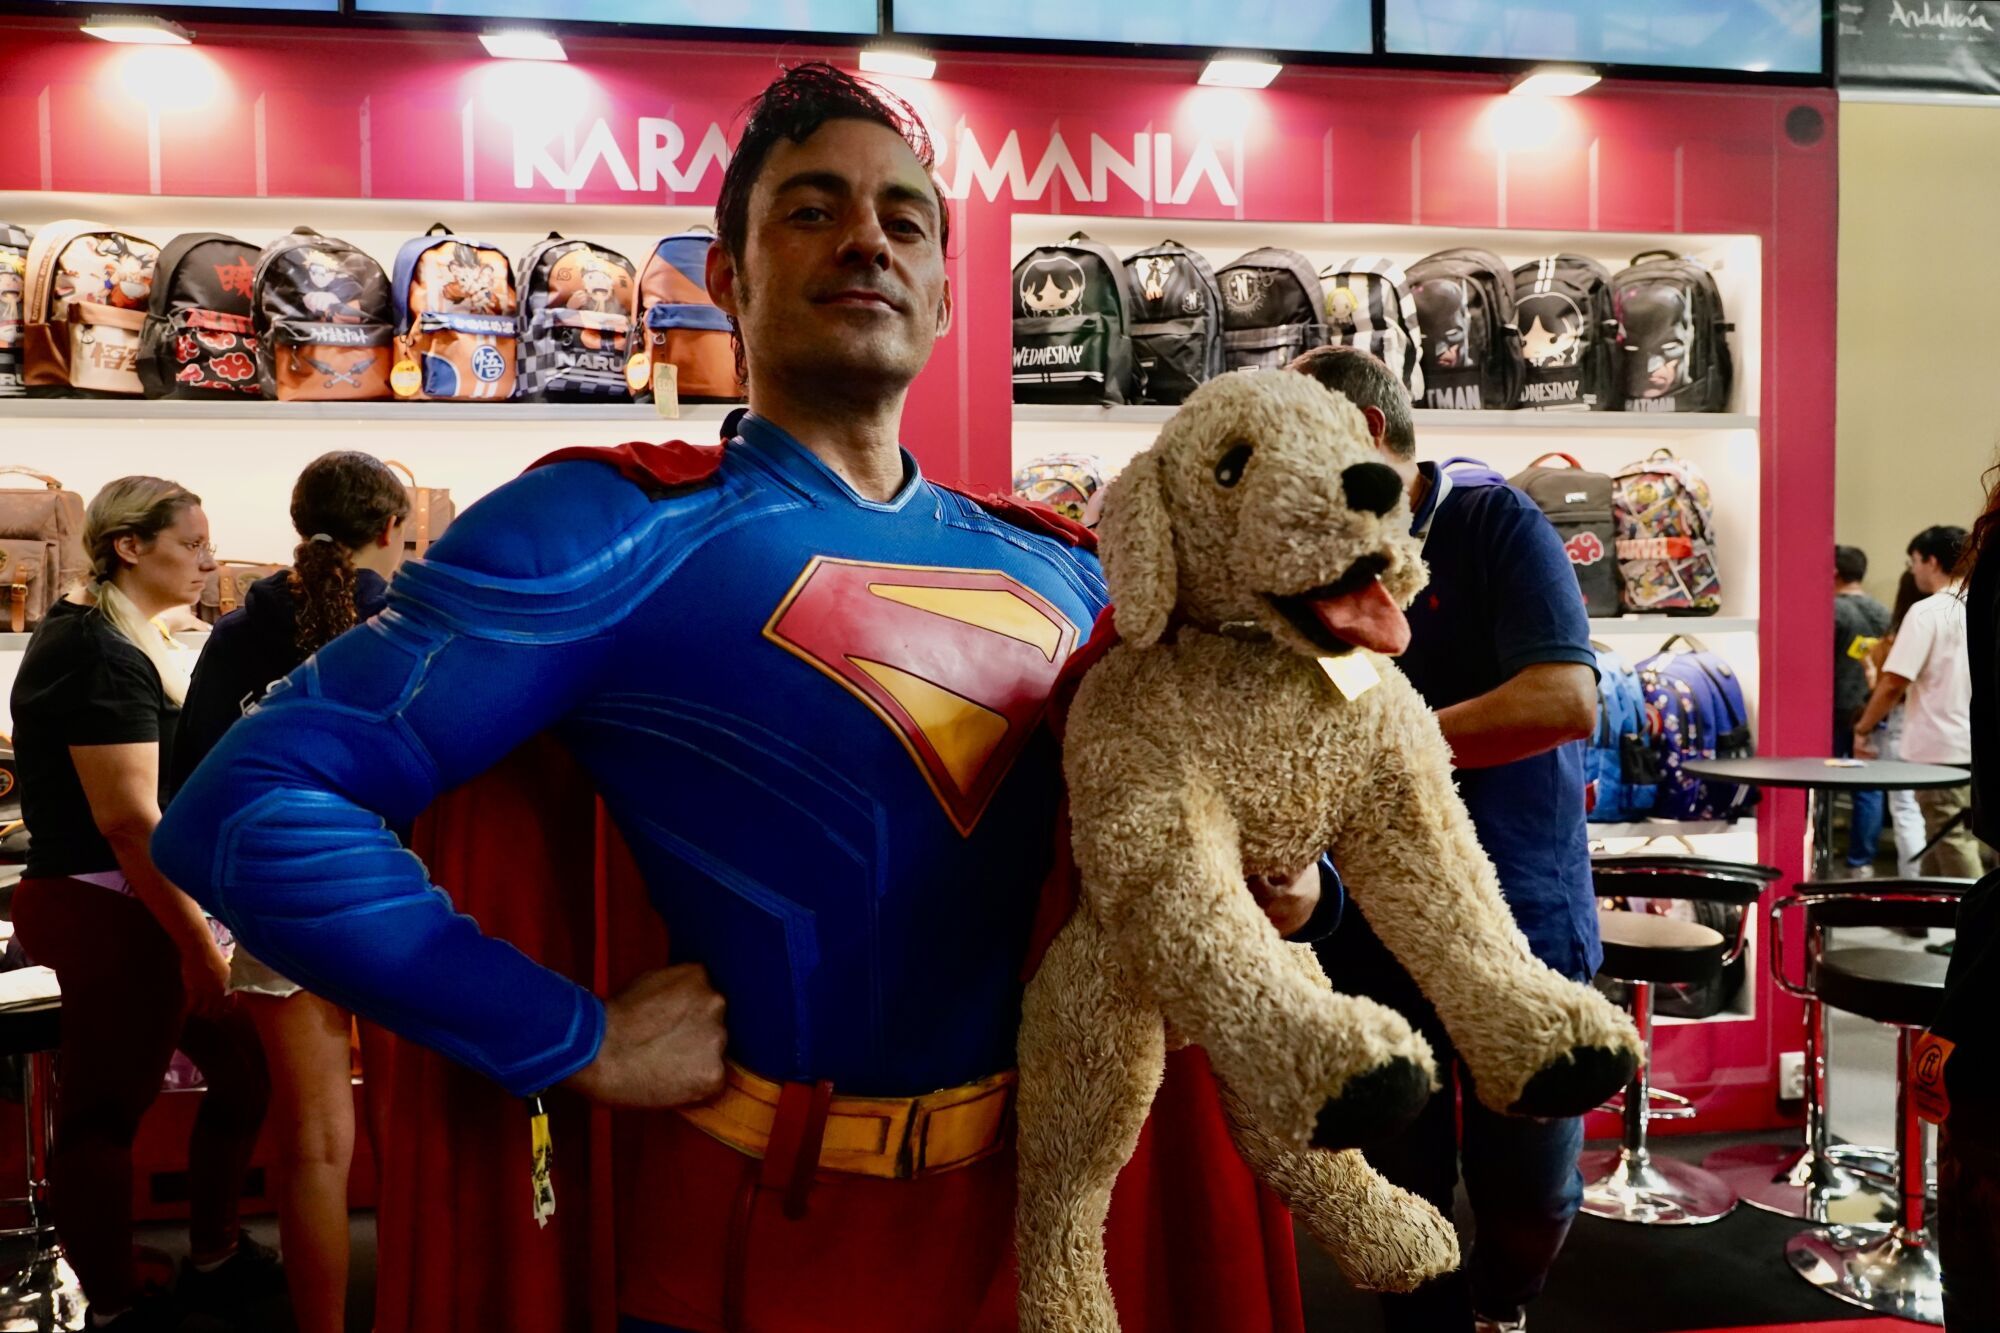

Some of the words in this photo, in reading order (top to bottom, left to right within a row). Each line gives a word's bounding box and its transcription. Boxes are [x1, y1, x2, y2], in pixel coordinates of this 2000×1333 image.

[555, 350, 624, 373] NARU
[1012, 345, 1083, 368] WEDNESDAY
[1427, 384, 1481, 410] TMAN
